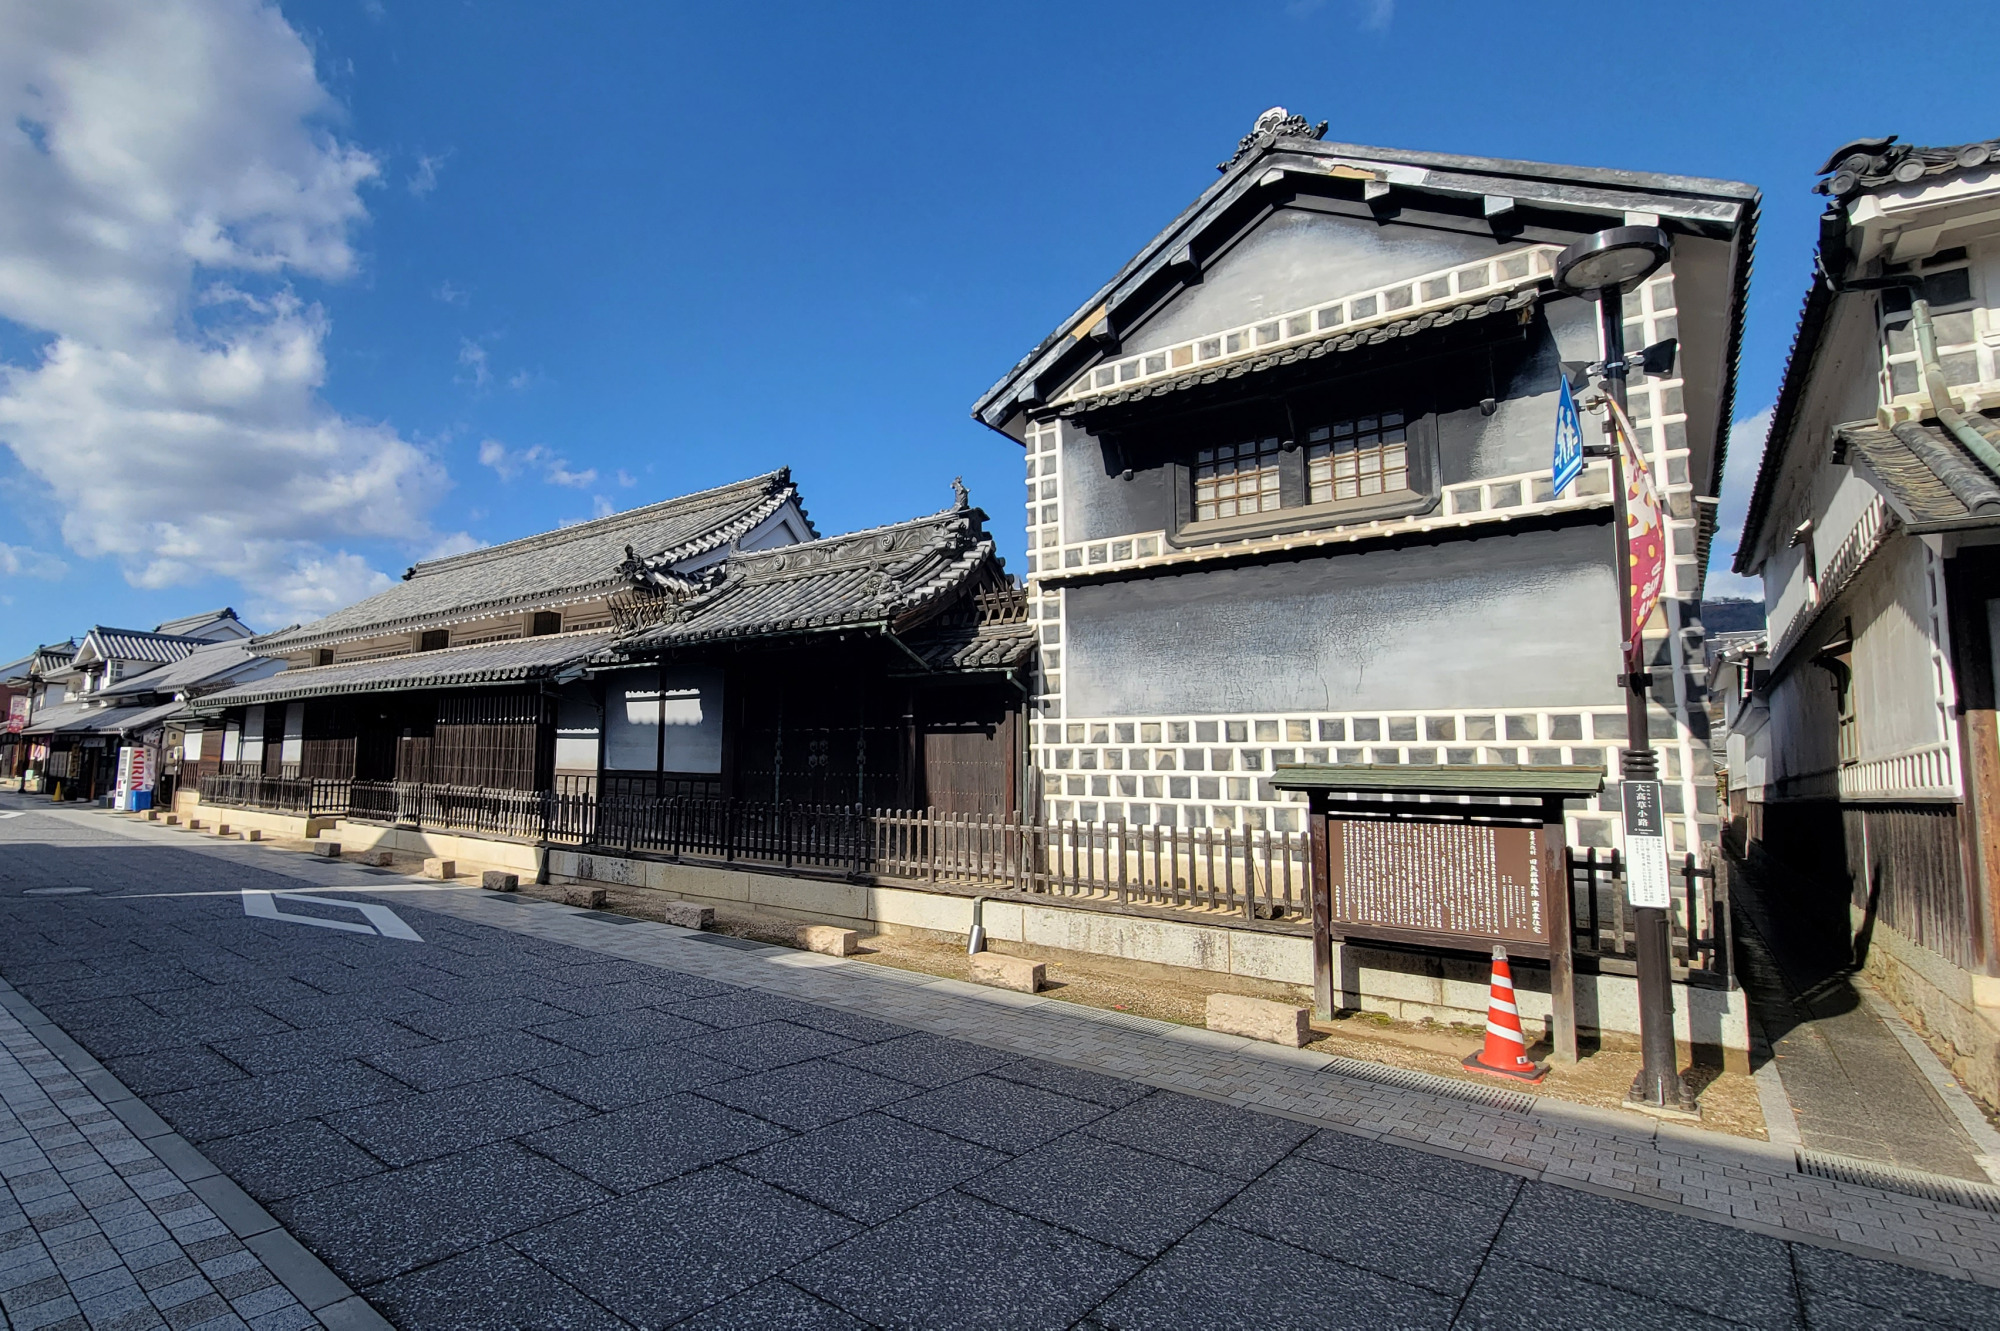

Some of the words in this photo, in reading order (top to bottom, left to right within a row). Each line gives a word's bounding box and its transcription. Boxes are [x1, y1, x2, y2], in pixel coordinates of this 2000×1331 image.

[131, 750, 144, 790] KIRIN
[1635, 784, 1649, 827] 大高草小路
